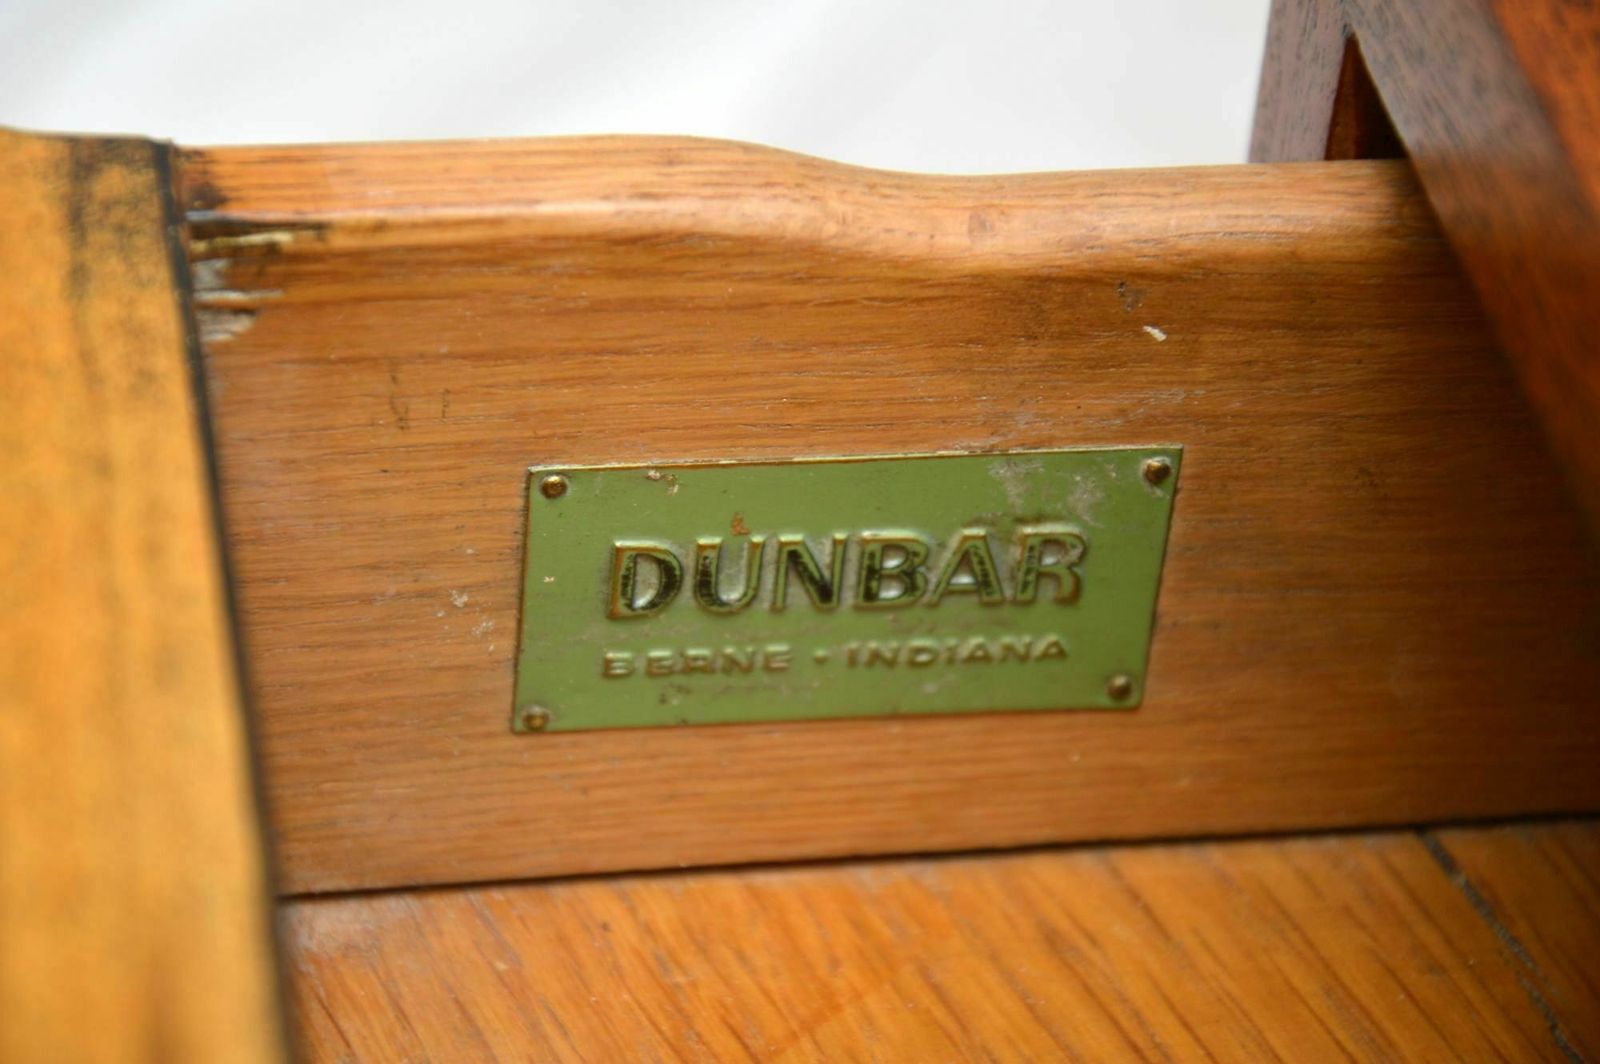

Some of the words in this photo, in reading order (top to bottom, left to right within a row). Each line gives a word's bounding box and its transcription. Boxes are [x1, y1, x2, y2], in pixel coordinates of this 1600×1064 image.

[607, 525, 1088, 619] DUNBAR
[603, 645, 793, 678] BERNE
[847, 633, 1068, 668] INDIANA
